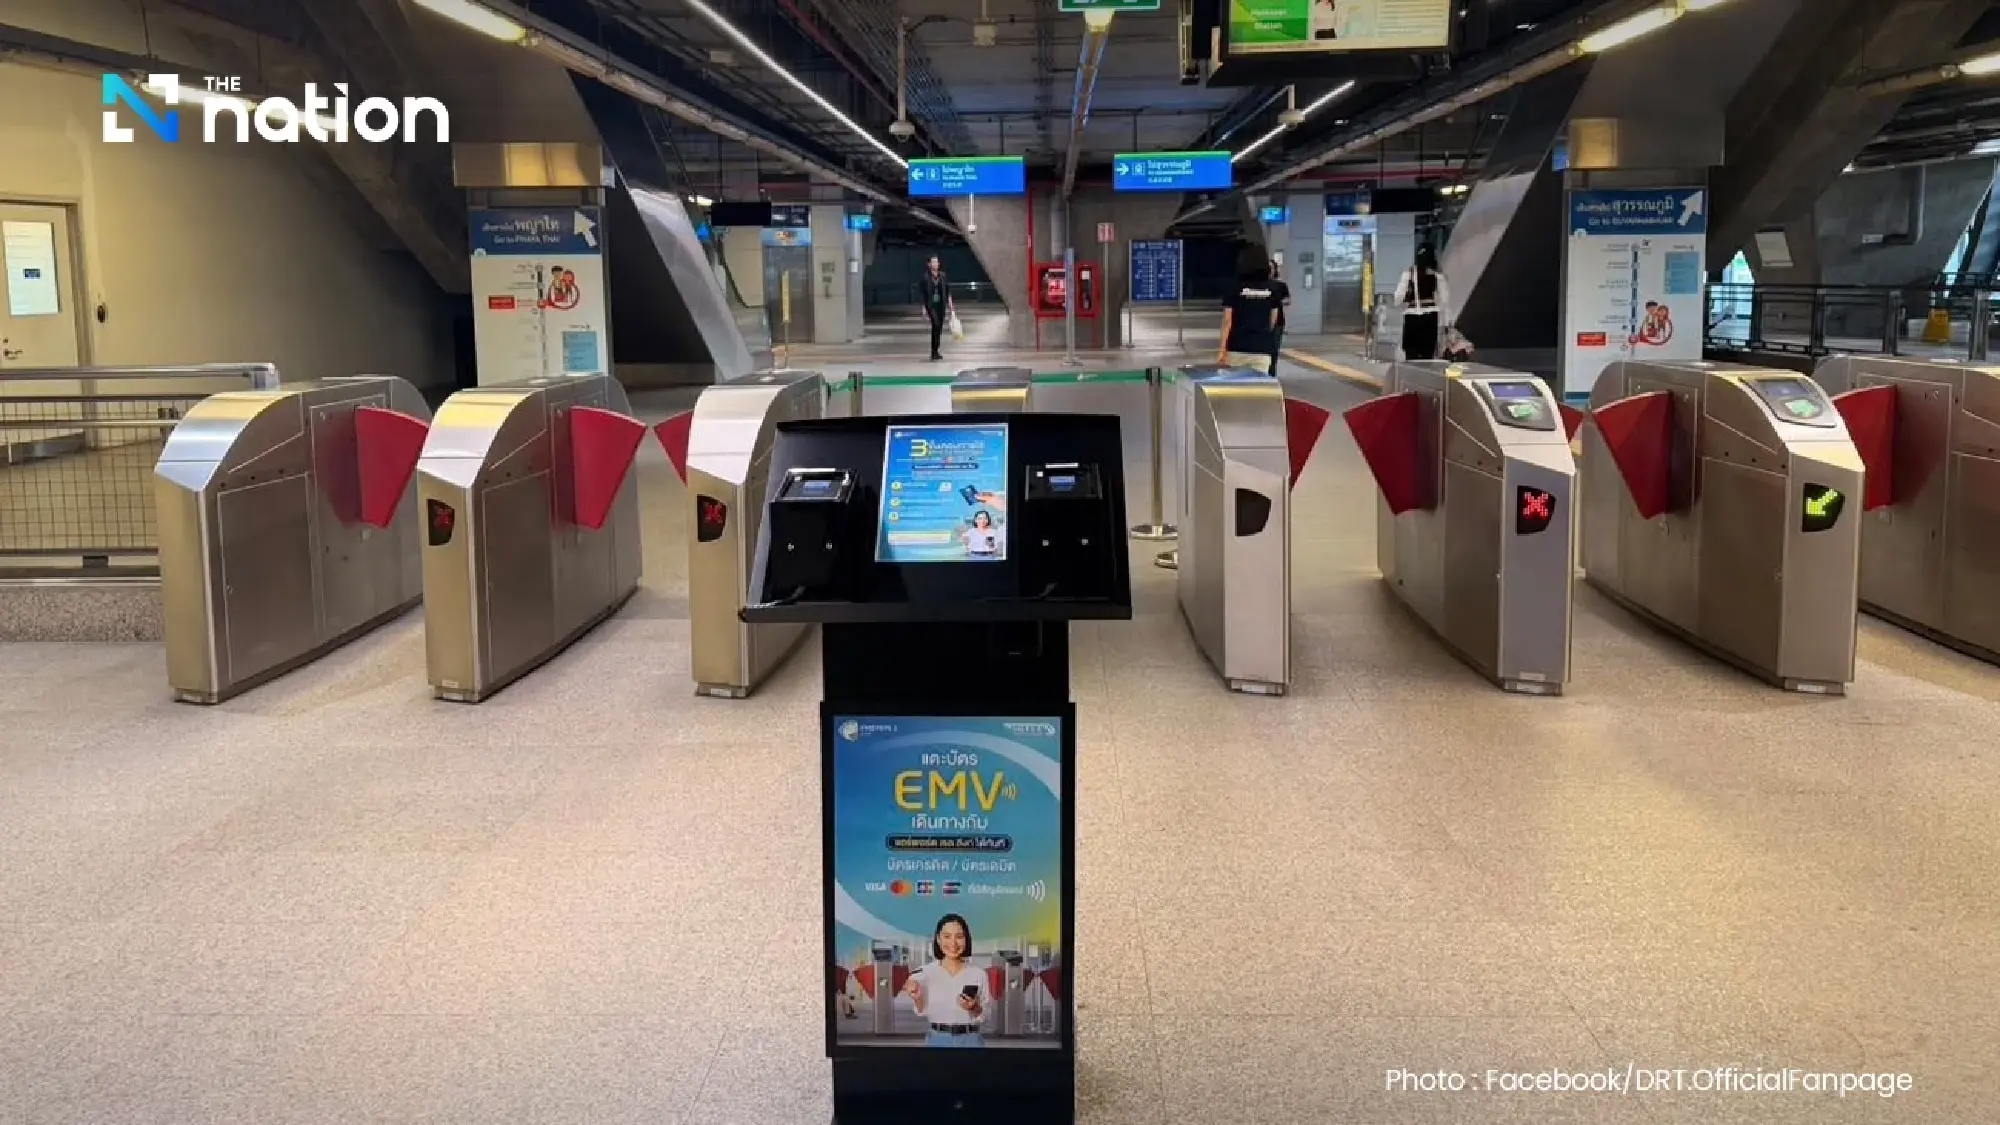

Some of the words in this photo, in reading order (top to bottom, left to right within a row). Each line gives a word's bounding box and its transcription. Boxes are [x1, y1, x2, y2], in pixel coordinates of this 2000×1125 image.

[921, 749, 978, 766] แตะบัตร
[893, 769, 1004, 812] EMV
[911, 813, 988, 830] เดินทางกับ
[865, 881, 887, 892] VISA
